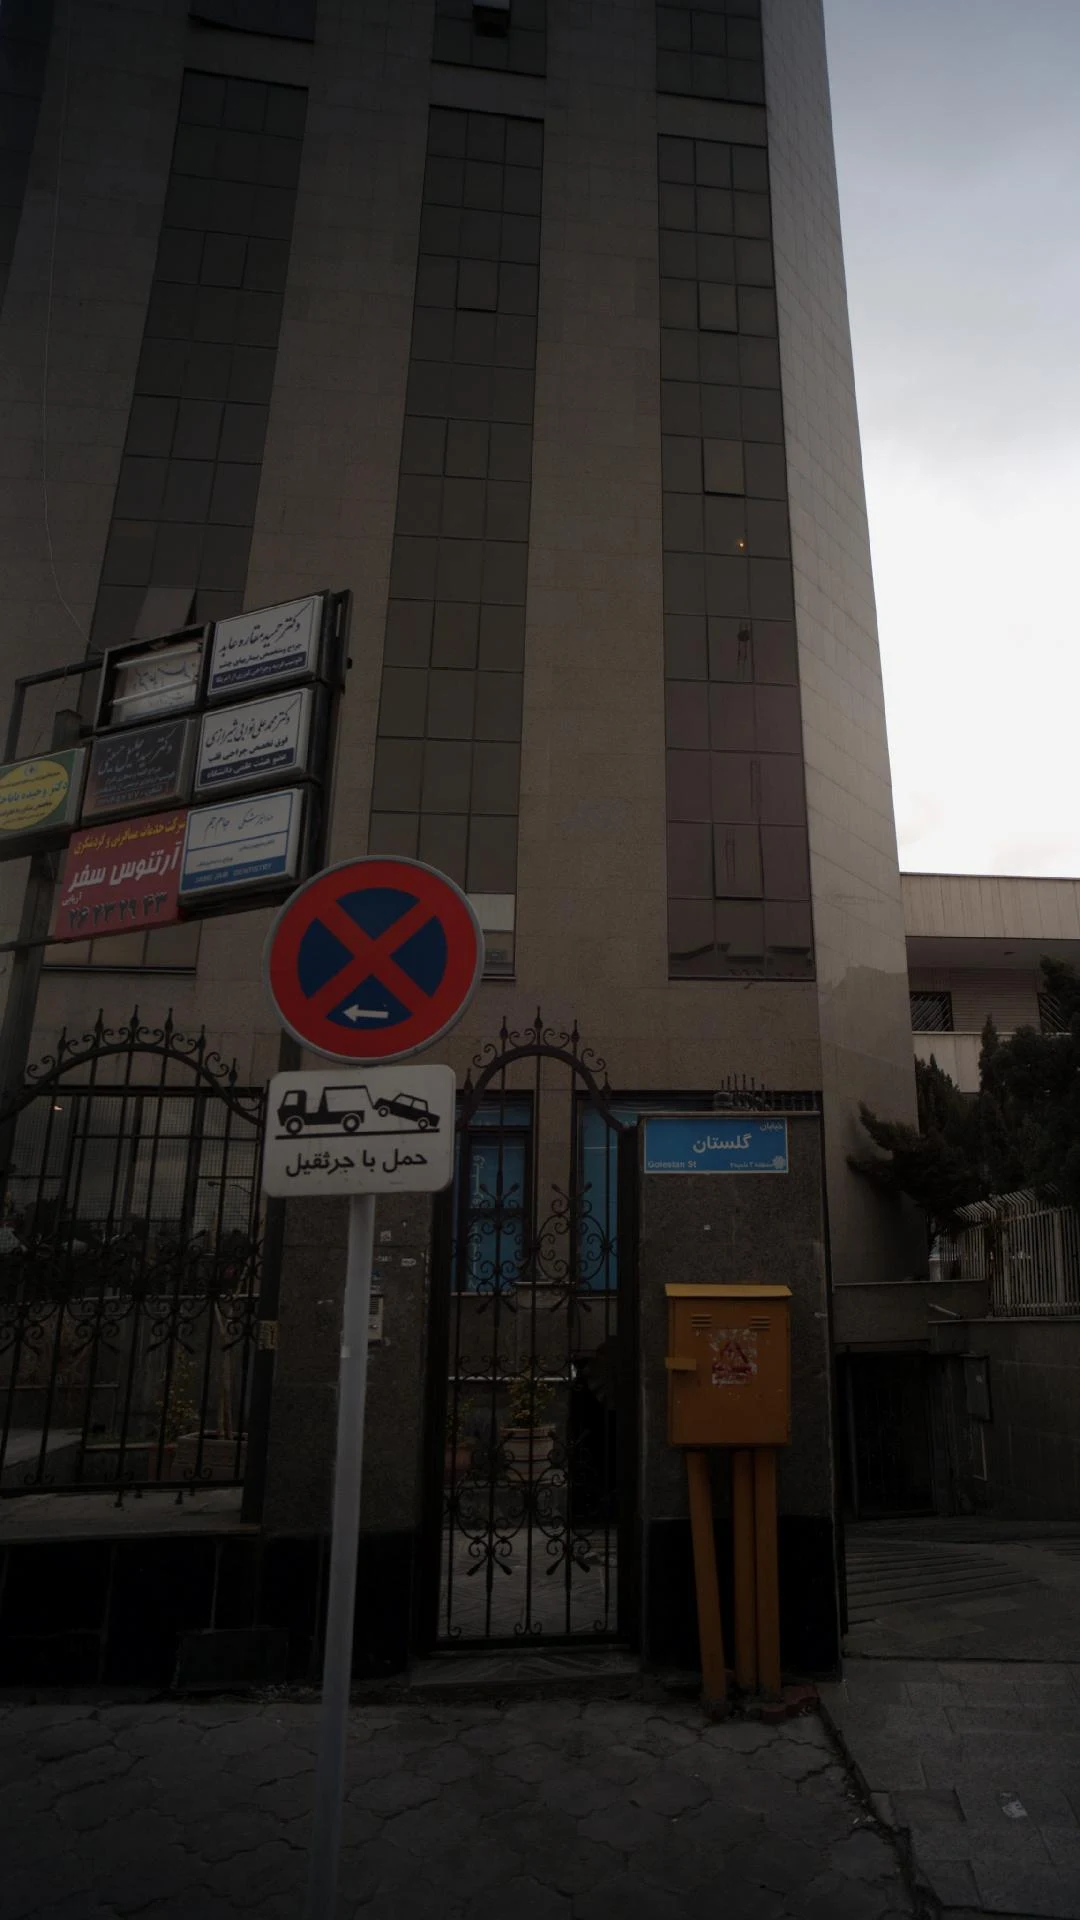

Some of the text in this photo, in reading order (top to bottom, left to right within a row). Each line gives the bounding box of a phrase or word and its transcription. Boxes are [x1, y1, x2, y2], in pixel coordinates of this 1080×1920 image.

[68, 841, 182, 892] آرتنوس سفر
[759, 1119, 784, 1132] خیابان
[692, 1132, 752, 1154] گلستان
[286, 1148, 427, 1177] حمل با جرثقیل
[648, 1159, 697, 1169] Golestan St
